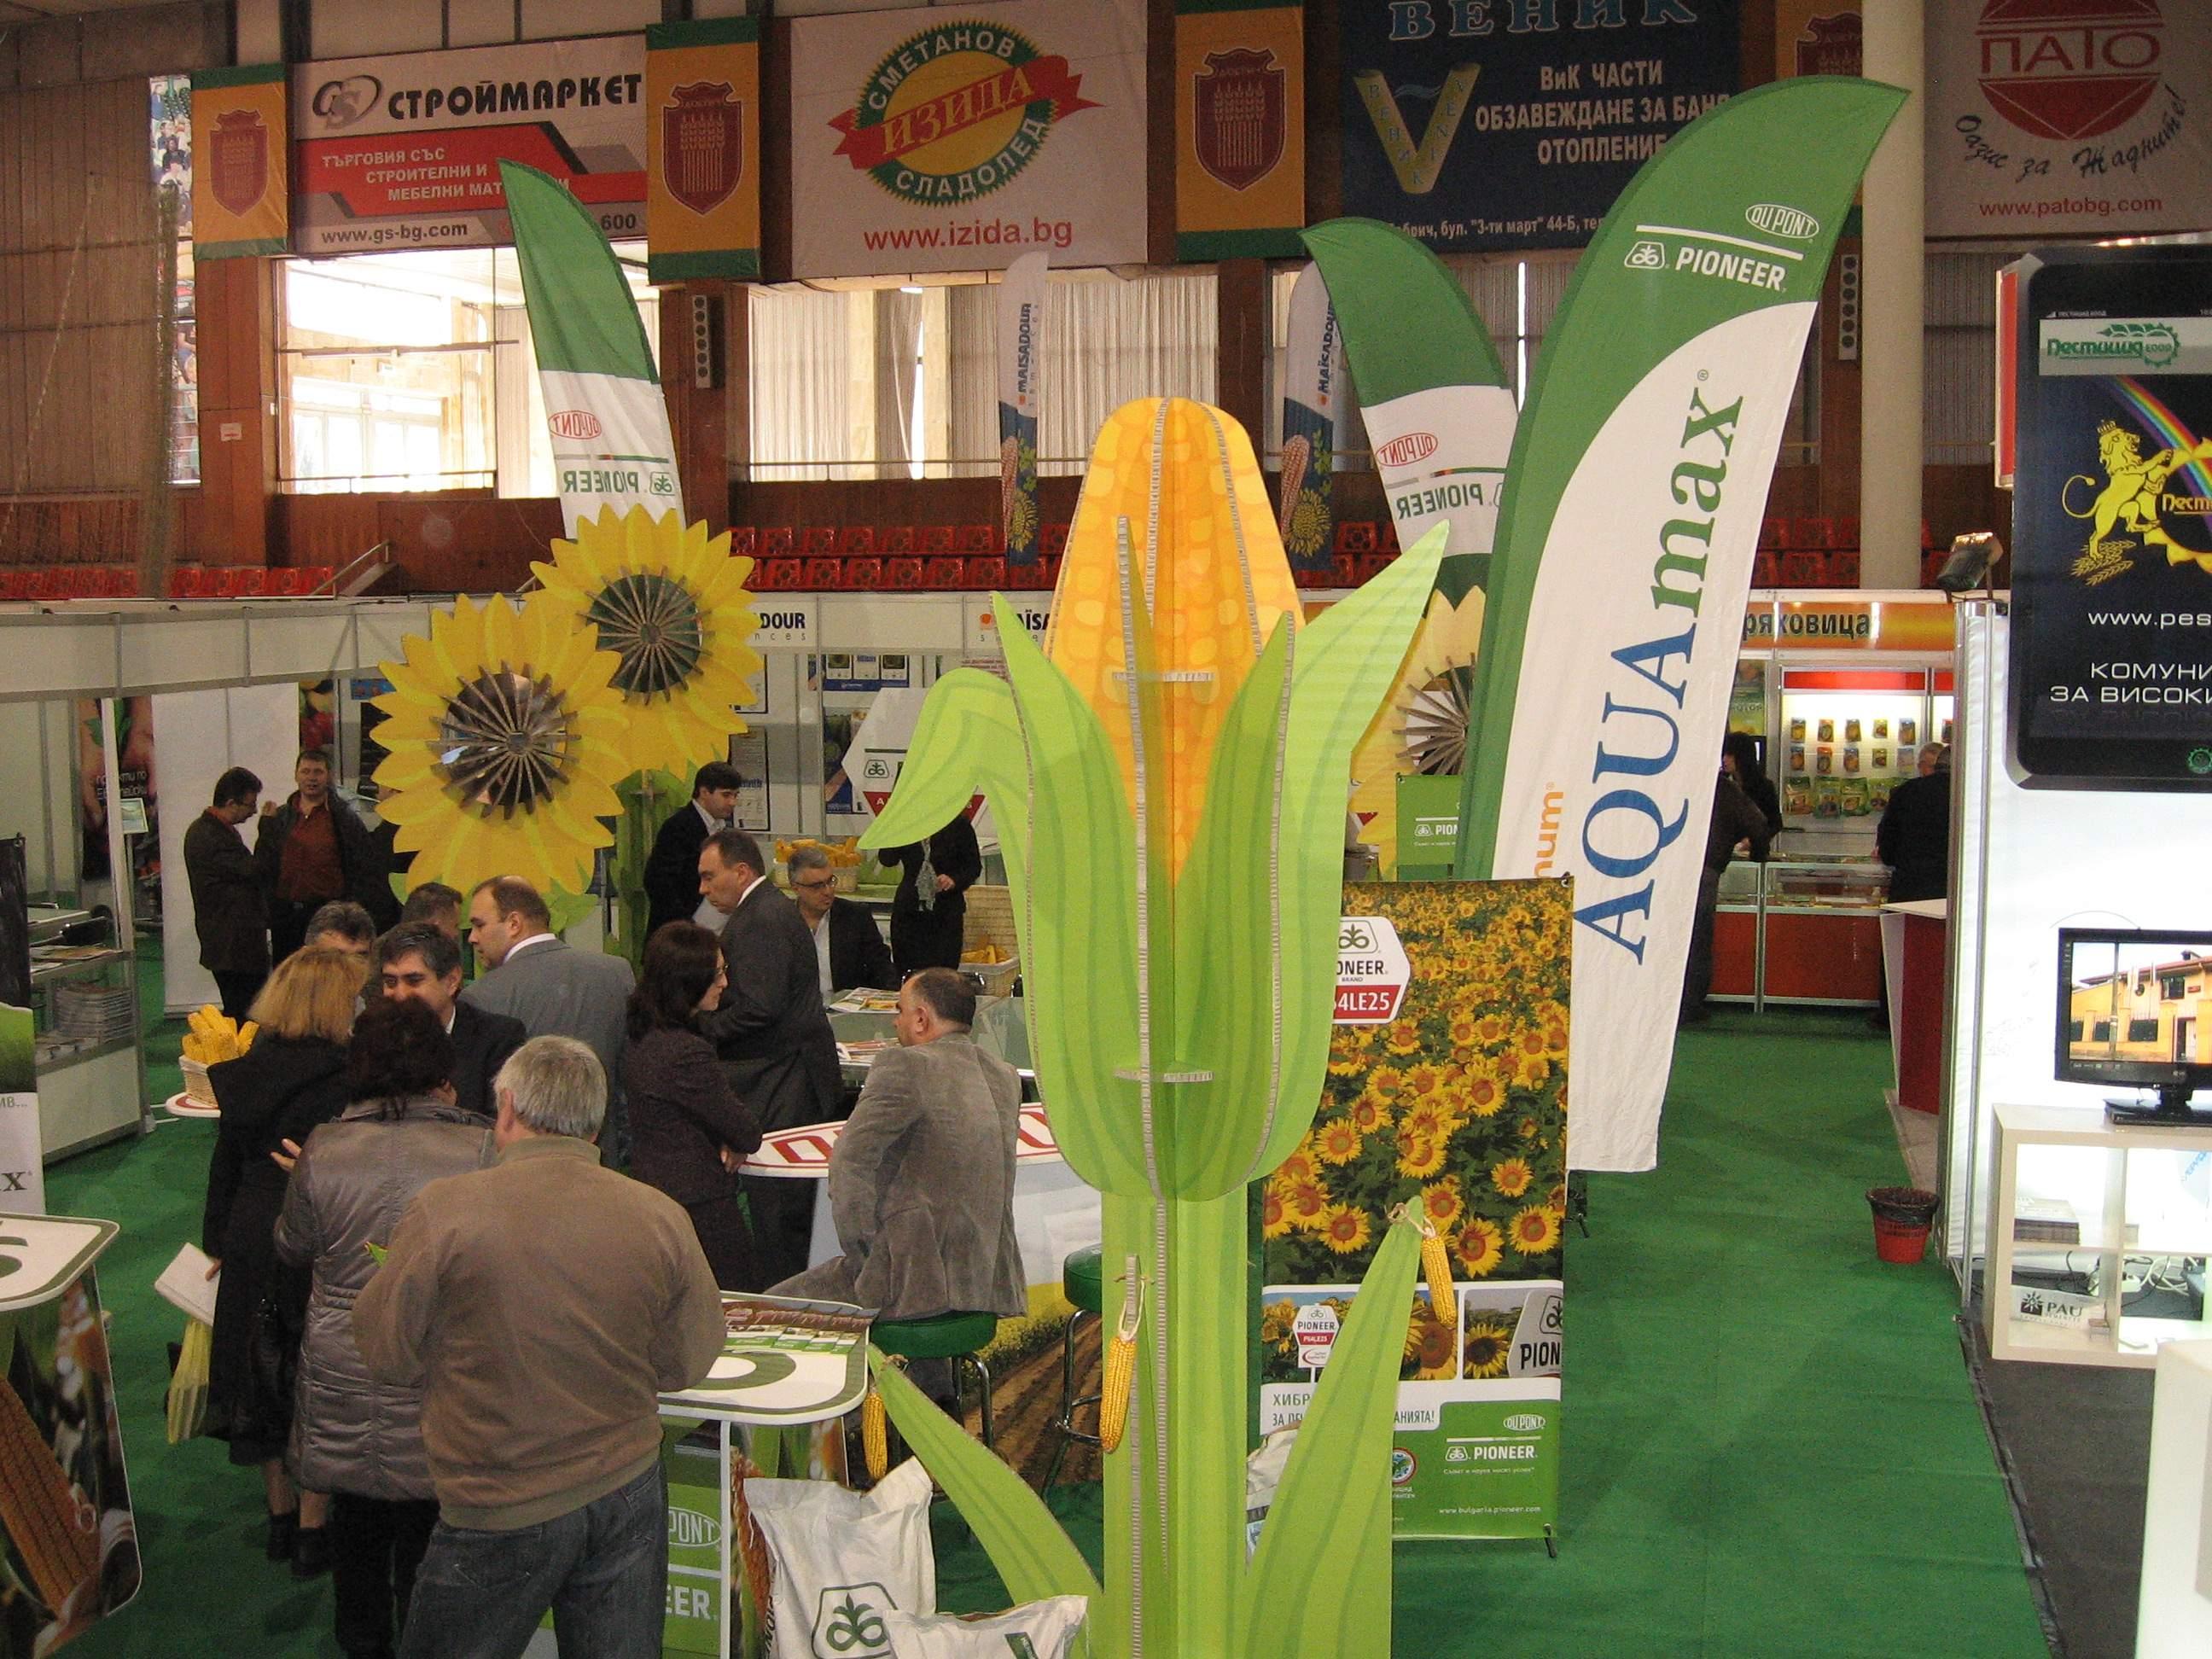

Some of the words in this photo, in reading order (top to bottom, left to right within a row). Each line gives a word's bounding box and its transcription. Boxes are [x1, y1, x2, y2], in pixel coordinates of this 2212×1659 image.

[1980, 31, 2161, 73] ПАТО
[866, 30, 1016, 112] СМЕТАНОВ
[1540, 65, 1580, 90] ВиК
[1592, 60, 1662, 88] ЧАСТИ
[388, 74, 642, 120] СТРОЙМАРКЕТ
[880, 66, 1037, 159] ИЗИДА
[1475, 97, 1634, 131] ОБЗАВЕЖДАНЕ
[1640, 96, 1667, 123] ЗА
[322, 151, 405, 168] ТЪРГОВИЯ
[410, 148, 445, 163] СЪС
[895, 116, 1049, 199] СЛАДОЛЕД
[366, 166, 470, 184] СТРОИТЕЛНИ
[476, 164, 487, 178] И
[388, 185, 463, 201] МЕБЕЛНИ
[1979, 196, 2163, 218] www.patobg.com
[601, 214, 637, 230] 600
[322, 224, 468, 244] www.gs-bg.com
[864, 217, 1074, 252] www.izida.bg
[1675, 247, 1786, 292] PIONEER
[758, 612, 806, 630] DOUR
[2050, 686, 2089, 702] ЗА
[1335, 992, 1389, 1011] 4LE25
[1272, 1413, 1284, 1426] ЗА
[1474, 1445, 1535, 1459] PIONEER
